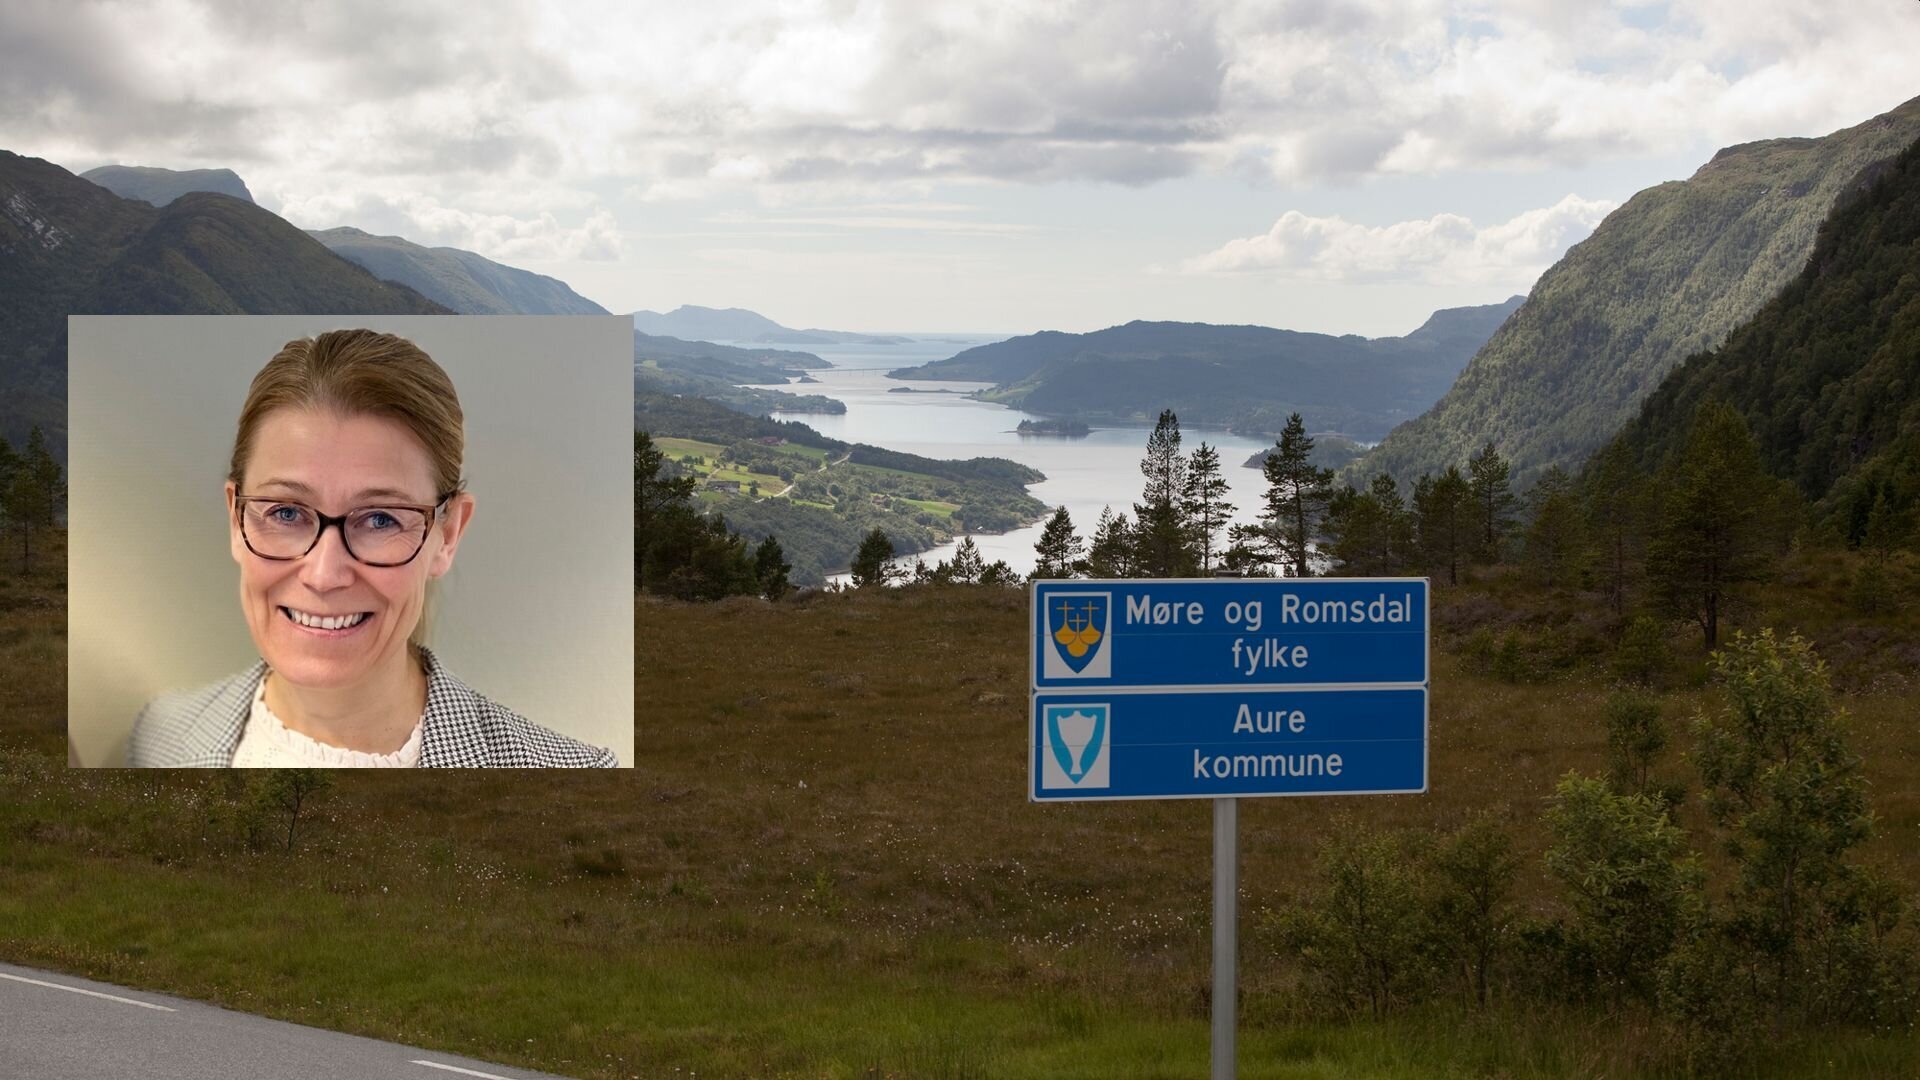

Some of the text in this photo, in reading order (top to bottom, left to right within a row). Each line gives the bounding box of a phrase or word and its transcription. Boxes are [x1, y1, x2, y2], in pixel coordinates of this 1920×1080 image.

[1126, 593, 1411, 632] Møre og Romsdal
[1231, 638, 1308, 676] fylke
[1233, 703, 1306, 733] Aure
[1193, 749, 1343, 778] kommune
